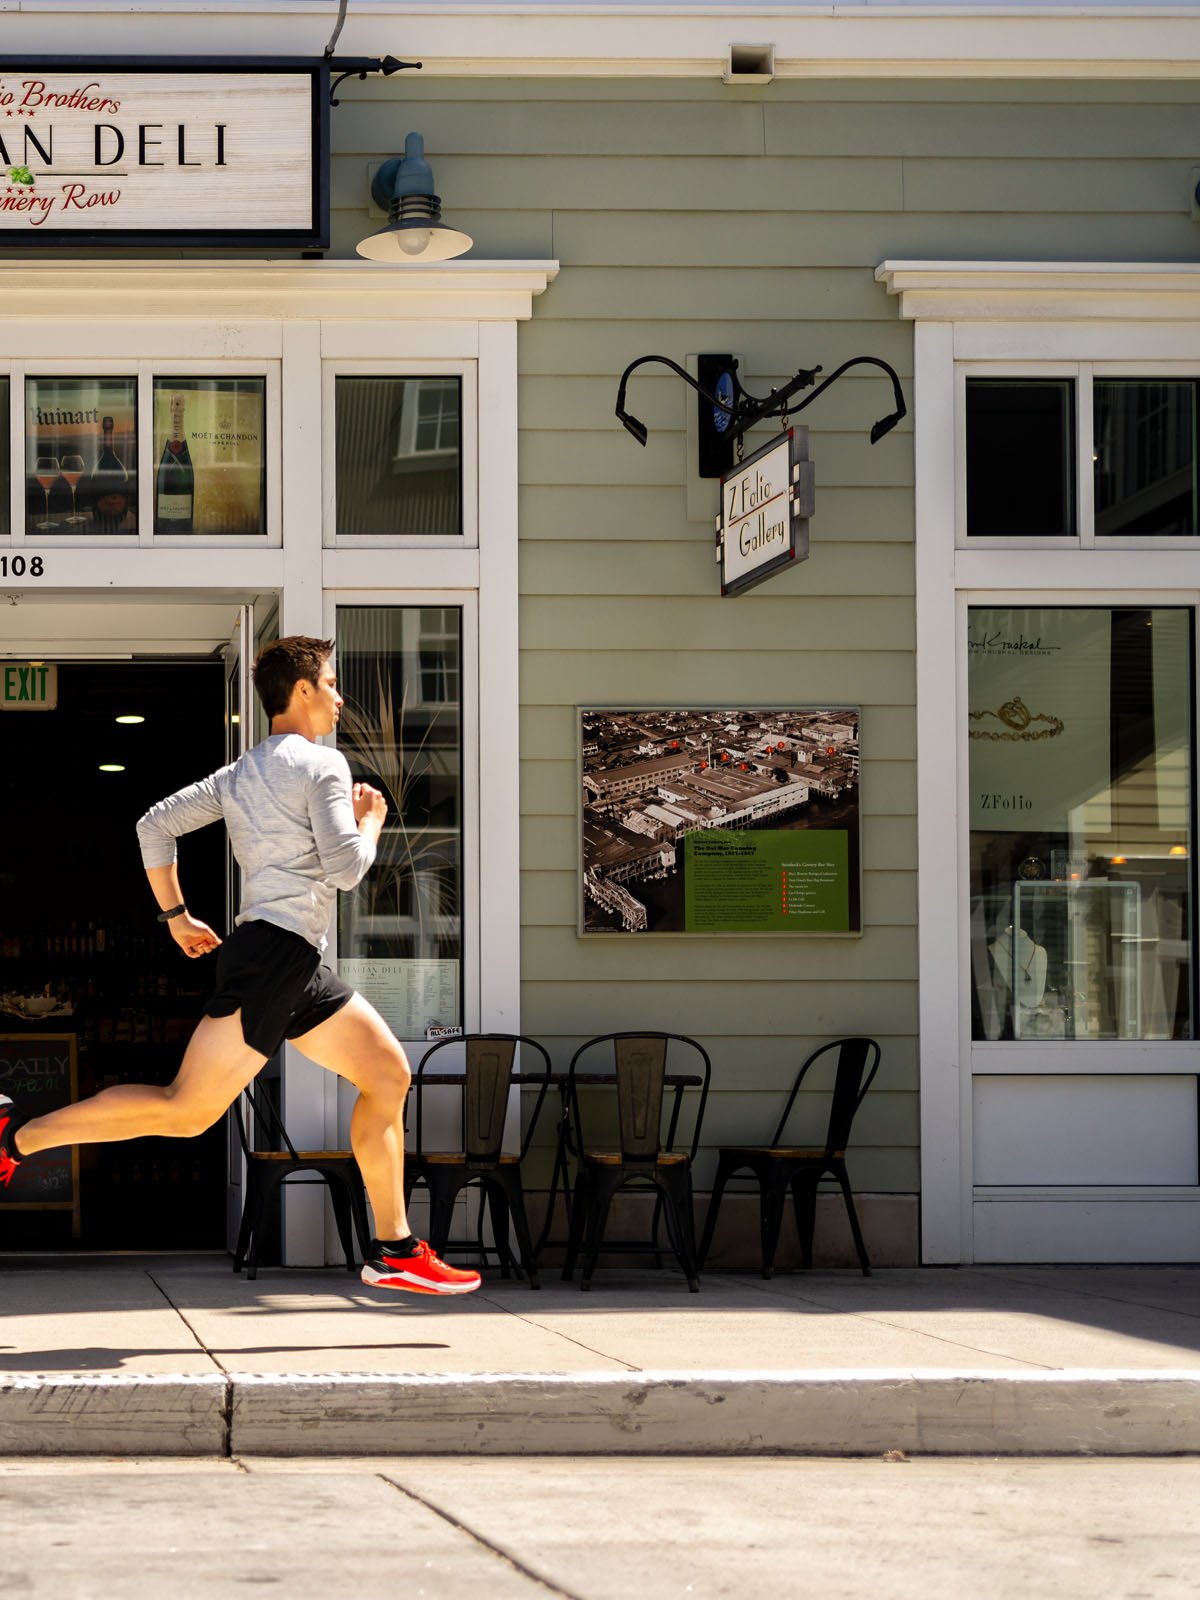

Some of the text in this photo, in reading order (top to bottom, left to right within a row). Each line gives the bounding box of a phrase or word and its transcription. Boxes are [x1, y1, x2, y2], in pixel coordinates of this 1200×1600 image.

[20, 81, 121, 115] Brothers
[94, 123, 228, 166] DELI
[61, 184, 121, 211] Row
[30, 406, 99, 426] Ruinart
[220, 433, 258, 441] CHANDON
[739, 511, 785, 557] Gallery
[0, 556, 45, 577] 108
[4, 667, 49, 701] EXIT
[981, 795, 1032, 810] ZFolio
